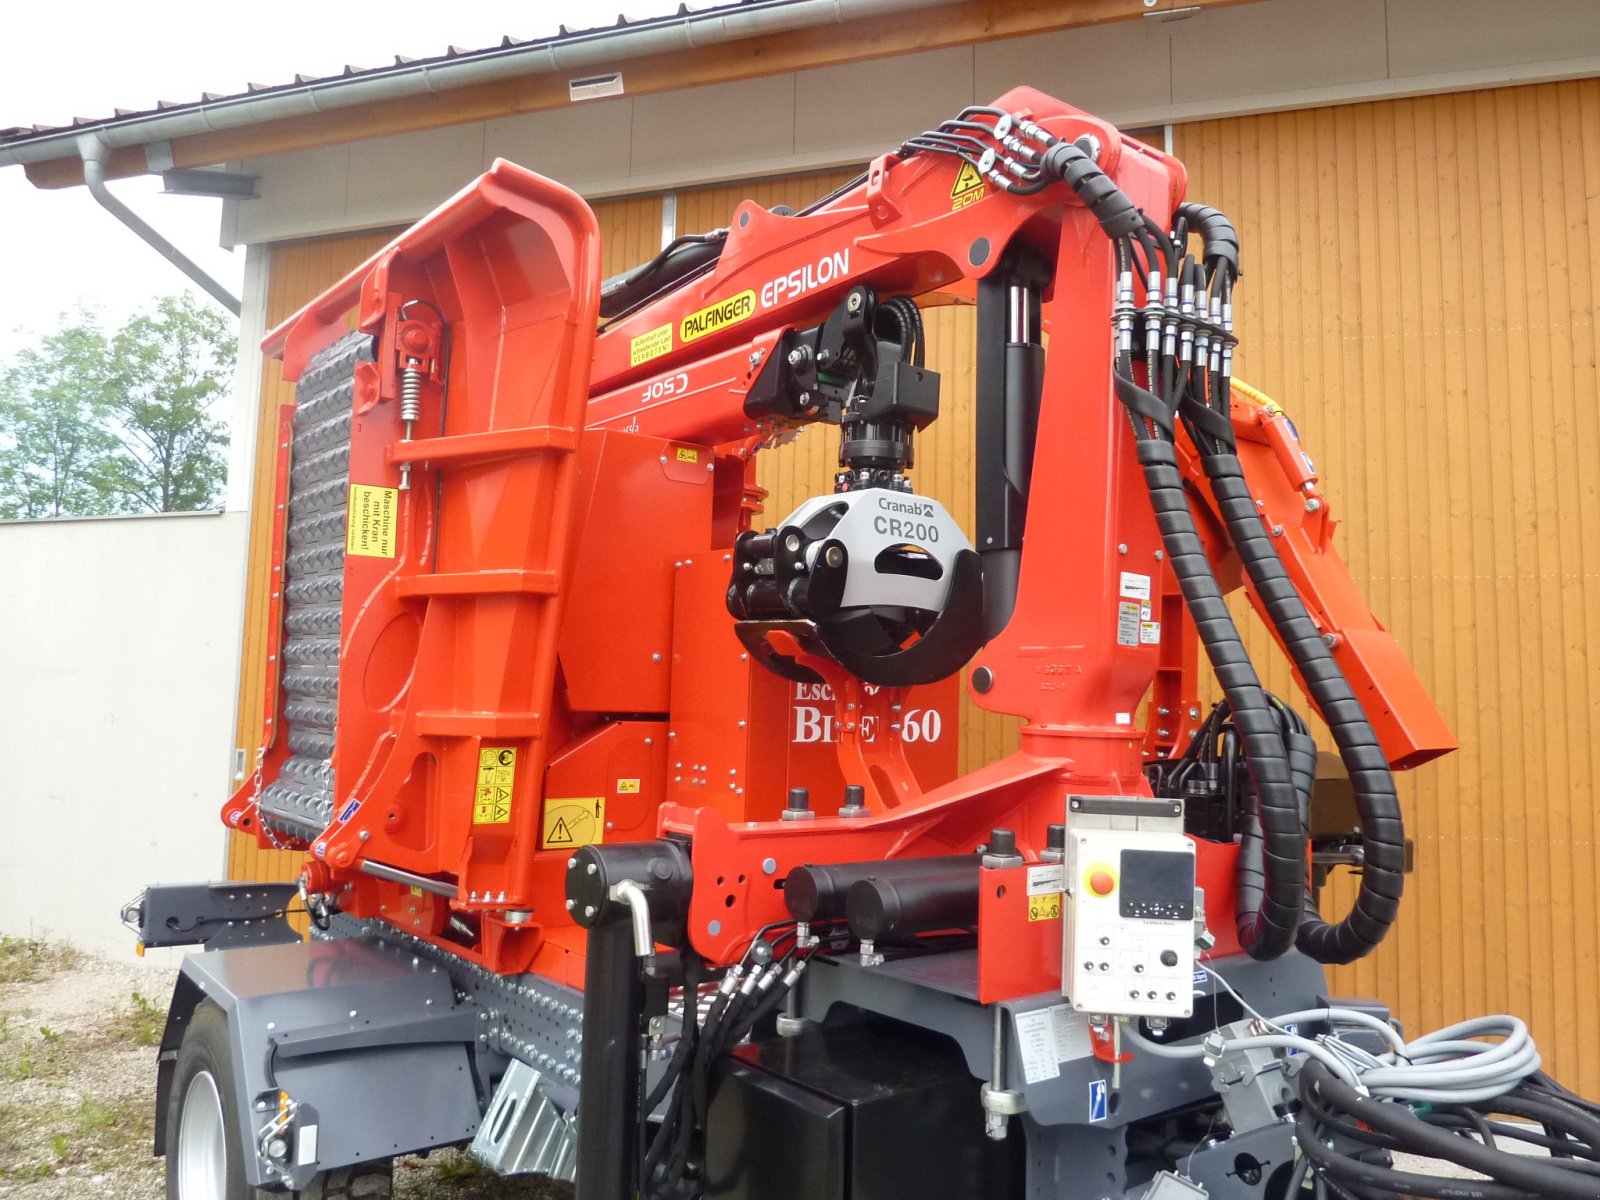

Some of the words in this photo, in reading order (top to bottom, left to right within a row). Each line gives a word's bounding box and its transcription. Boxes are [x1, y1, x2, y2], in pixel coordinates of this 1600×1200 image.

[952, 187, 984, 210] 20M
[761, 248, 849, 308] EPSILON
[684, 295, 751, 338] PALFINGER
[641, 373, 688, 403] C50F
[361, 491, 371, 550] beschicken!
[372, 501, 381, 516] mit
[382, 490, 393, 536] Maschine
[878, 497, 922, 516] Cranab
[371, 519, 381, 542] Kran
[874, 516, 939, 542] CR200
[902, 708, 942, 743] 60
